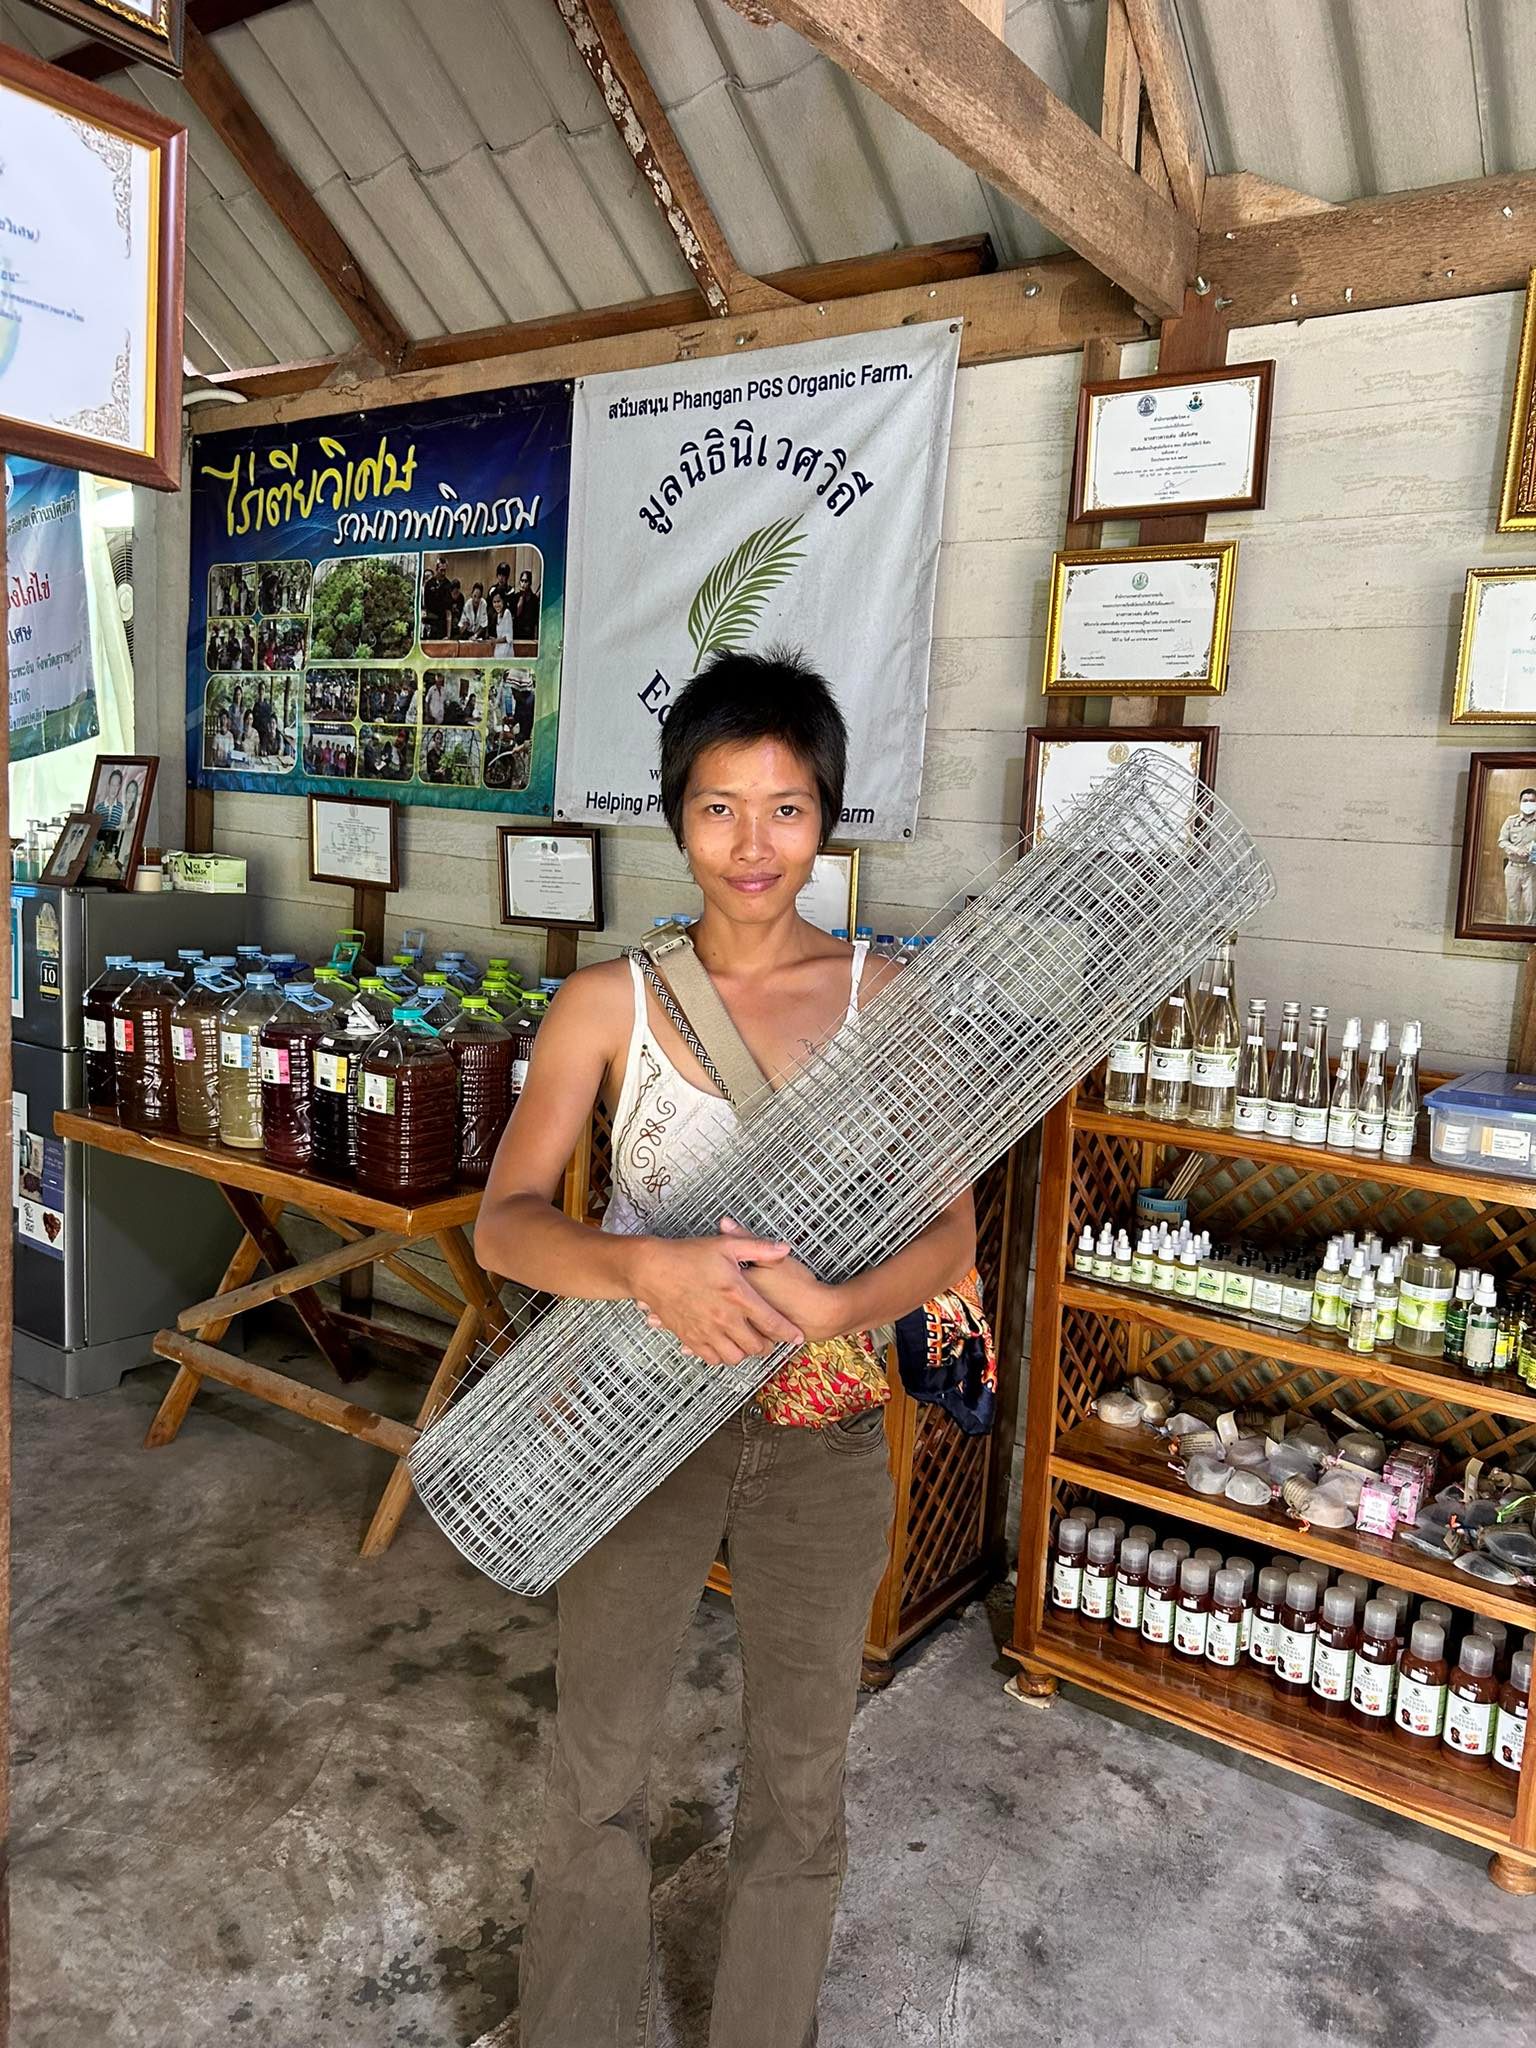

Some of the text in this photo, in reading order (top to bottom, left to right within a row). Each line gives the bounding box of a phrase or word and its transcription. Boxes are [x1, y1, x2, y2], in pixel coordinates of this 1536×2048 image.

[608, 362, 914, 420] สนับสนุน Phangan PGS Organic Farm.
[639, 419, 874, 535] มูลนิธินิเวศวิถี
[333, 482, 541, 545] รวมภาพกิจกรรม
[8, 625, 32, 645] เศษ
[586, 791, 643, 816] Helping
[840, 805, 875, 824] arm
[43, 968, 56, 984] 10
